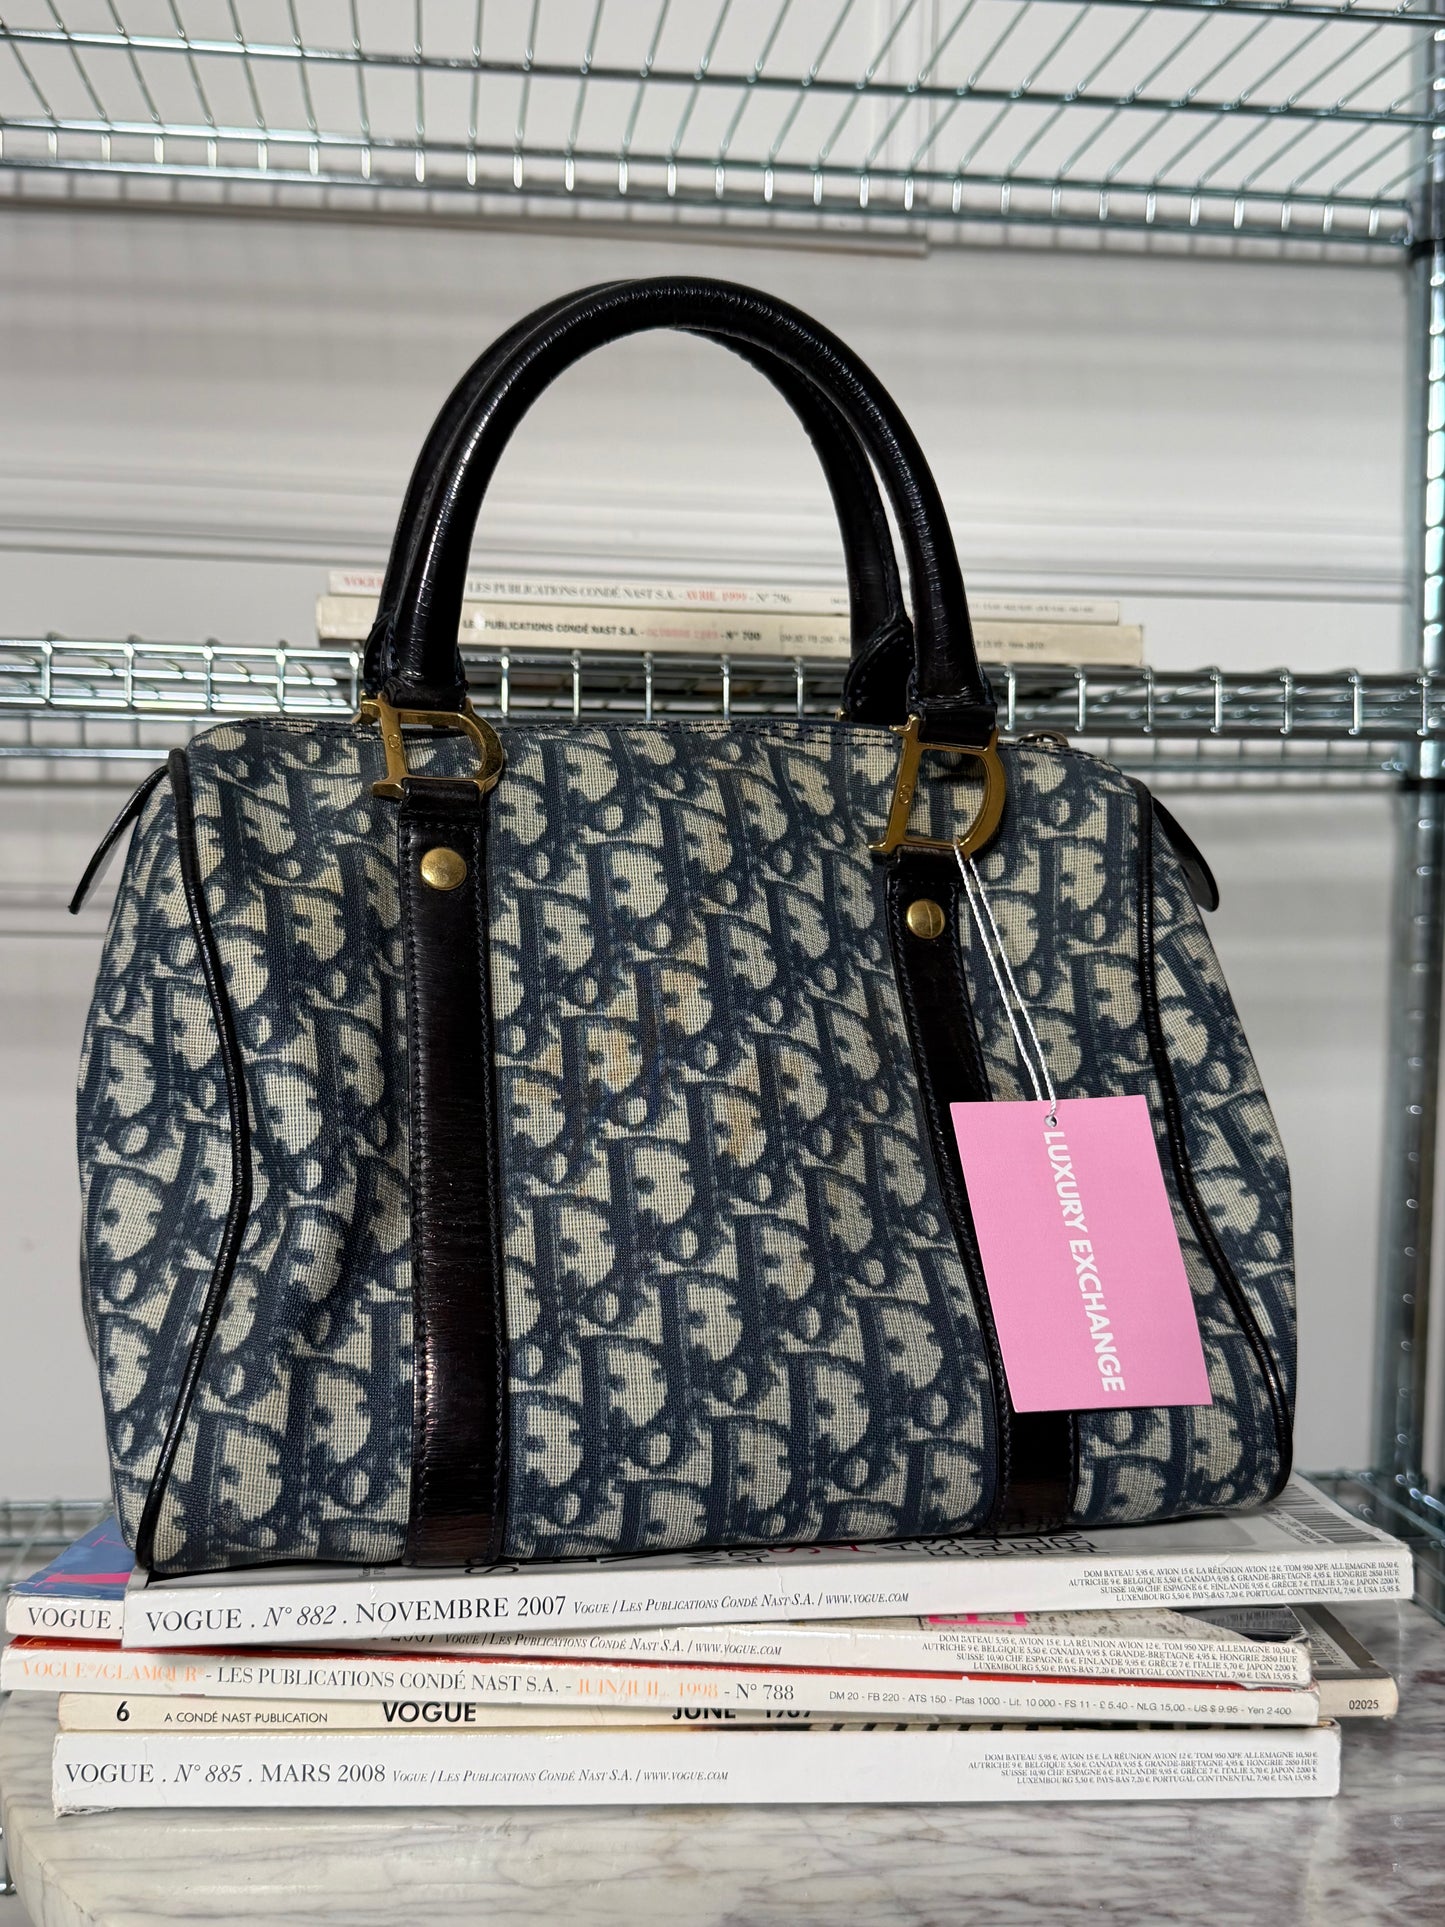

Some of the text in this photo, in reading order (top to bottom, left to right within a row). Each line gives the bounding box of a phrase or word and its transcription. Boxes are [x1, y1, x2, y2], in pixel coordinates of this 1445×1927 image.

[468, 581, 491, 593] LES
[494, 582, 577, 597] PUBLICATIONS
[580, 583, 621, 598] CONDÉ
[624, 587, 653, 599] NAST
[655, 589, 676, 600] S.A.
[484, 620, 553, 632] PUBLICATIONS
[556, 621, 589, 634] CONDÉ
[591, 625, 616, 635] NAST
[618, 626, 637, 637] S.A.
[1043, 1131, 1125, 1392] LUXURY EXCHANGE
[1068, 1569, 1368, 1587] AUTRICHE BELGIQUE CANADA GRANDE-BRETAGNE HONGRIE
[1103, 1561, 1377, 1578] BATEAU AVION RÉUNION AVION ALLEMAGNE
[1100, 1577, 1379, 1594] SUISSE ESPAGNE FINLANDE GRÈCE ITALIE JAPON
[1116, 1587, 1343, 1602] LUXEMBOURG PAYS-BAS PORTUGAL CONTINENTAL
[573, 1600, 610, 1614] VOGUE
[619, 1599, 643, 1613] LES
[645, 1597, 720, 1612] PUBLICATIONS
[721, 1595, 759, 1609] CONDÉ
[760, 1594, 791, 1607] NAST
[791, 1593, 815, 1606] S.A.
[28, 1607, 111, 1630] VOGUE
[145, 1595, 567, 1632] VOGUE N° 882 NOVEMBRE 2007
[445, 1633, 481, 1645] VOGUE
[489, 1632, 512, 1646] LES
[514, 1634, 588, 1649] PUBLICATIONS
[590, 1634, 627, 1650] CONDÉ
[629, 1637, 659, 1652] NAST
[660, 1638, 685, 1653] S.A.
[1018, 1637, 1044, 1646] AVION
[1076, 1637, 1117, 1648] RÉUNION
[1117, 1640, 1143, 1649] AVION
[1217, 1644, 1271, 1654] ALLEMAGNE
[922, 1643, 1260, 1662] AUTRICHE BELGIQUE CANADA GRANDE-BRETAGNE HONGRIE
[956, 1653, 1273, 1671] SUISSE ESPAGNE FINLANDE GRÈCE ITALIE JAPON
[973, 1662, 1229, 1679] LUXEMBOURG PAYS-BAS PORTUGAL CONTINENTAL
[217, 1666, 253, 1684] LES
[258, 1667, 395, 1689] PUBLICATIONS
[399, 1670, 466, 1690] CONDÉ
[471, 1674, 523, 1692] NAST
[525, 1676, 559, 1694] S.A.
[576, 1678, 671, 1698] JUIN/JUIL.
[677, 1681, 719, 1699] 1998
[736, 1682, 758, 1700] N°
[762, 1683, 795, 1701] 788
[115, 1700, 130, 1722] 6
[381, 1701, 477, 1722] VOGUE
[829, 1691, 845, 1700] DM
[847, 1692, 859, 1701] 20
[867, 1692, 880, 1701] FB
[882, 1692, 900, 1702] 220
[907, 1693, 928, 1703] ATS
[930, 1694, 947, 1704] 150
[954, 1695, 975, 1705] Ptas
[977, 1696, 1001, 1706] 1000
[1008, 1697, 1022, 1706] Lit.
[1026, 1697, 1037, 1707] 10
[1038, 1698, 1056, 1707] 000
[1064, 1699, 1077, 1708] FS
[1080, 1699, 1090, 1709] 11
[1136, 1701, 1157, 1711] NLG
[1193, 1703, 1207, 1713] US
[1247, 1705, 1265, 1715] Yen
[1275, 1707, 1292, 1716] 400
[1348, 1699, 1379, 1710] 02025
[163, 1709, 328, 1723] A CONDÉ NAST PUBLICATION
[968, 1758, 1284, 1770] AUTRICHE BELGIQUE CANADA GRANDE-BRETAGNE HONGRIE
[1005, 1750, 1295, 1761] BATEAU RÉUNION ALLEMAGNE
[64, 1763, 386, 1784] VOGUE N° 885 MARS 2008
[391, 1770, 428, 1783] VOGUE
[437, 1769, 460, 1783] LES
[462, 1769, 536, 1783] PUBLICATIONS
[537, 1768, 575, 1782] CONDÉ
[577, 1769, 607, 1782] NAST
[608, 1769, 632, 1782] S.A.
[1000, 1765, 1295, 1777] SUISSE ESPAGNE FINLANDE GRÈCE ITALIE JAPON
[1016, 1774, 1255, 1785] LUXEMBOURG PAYS-BAS PORTUGAL CONTINENTAL
